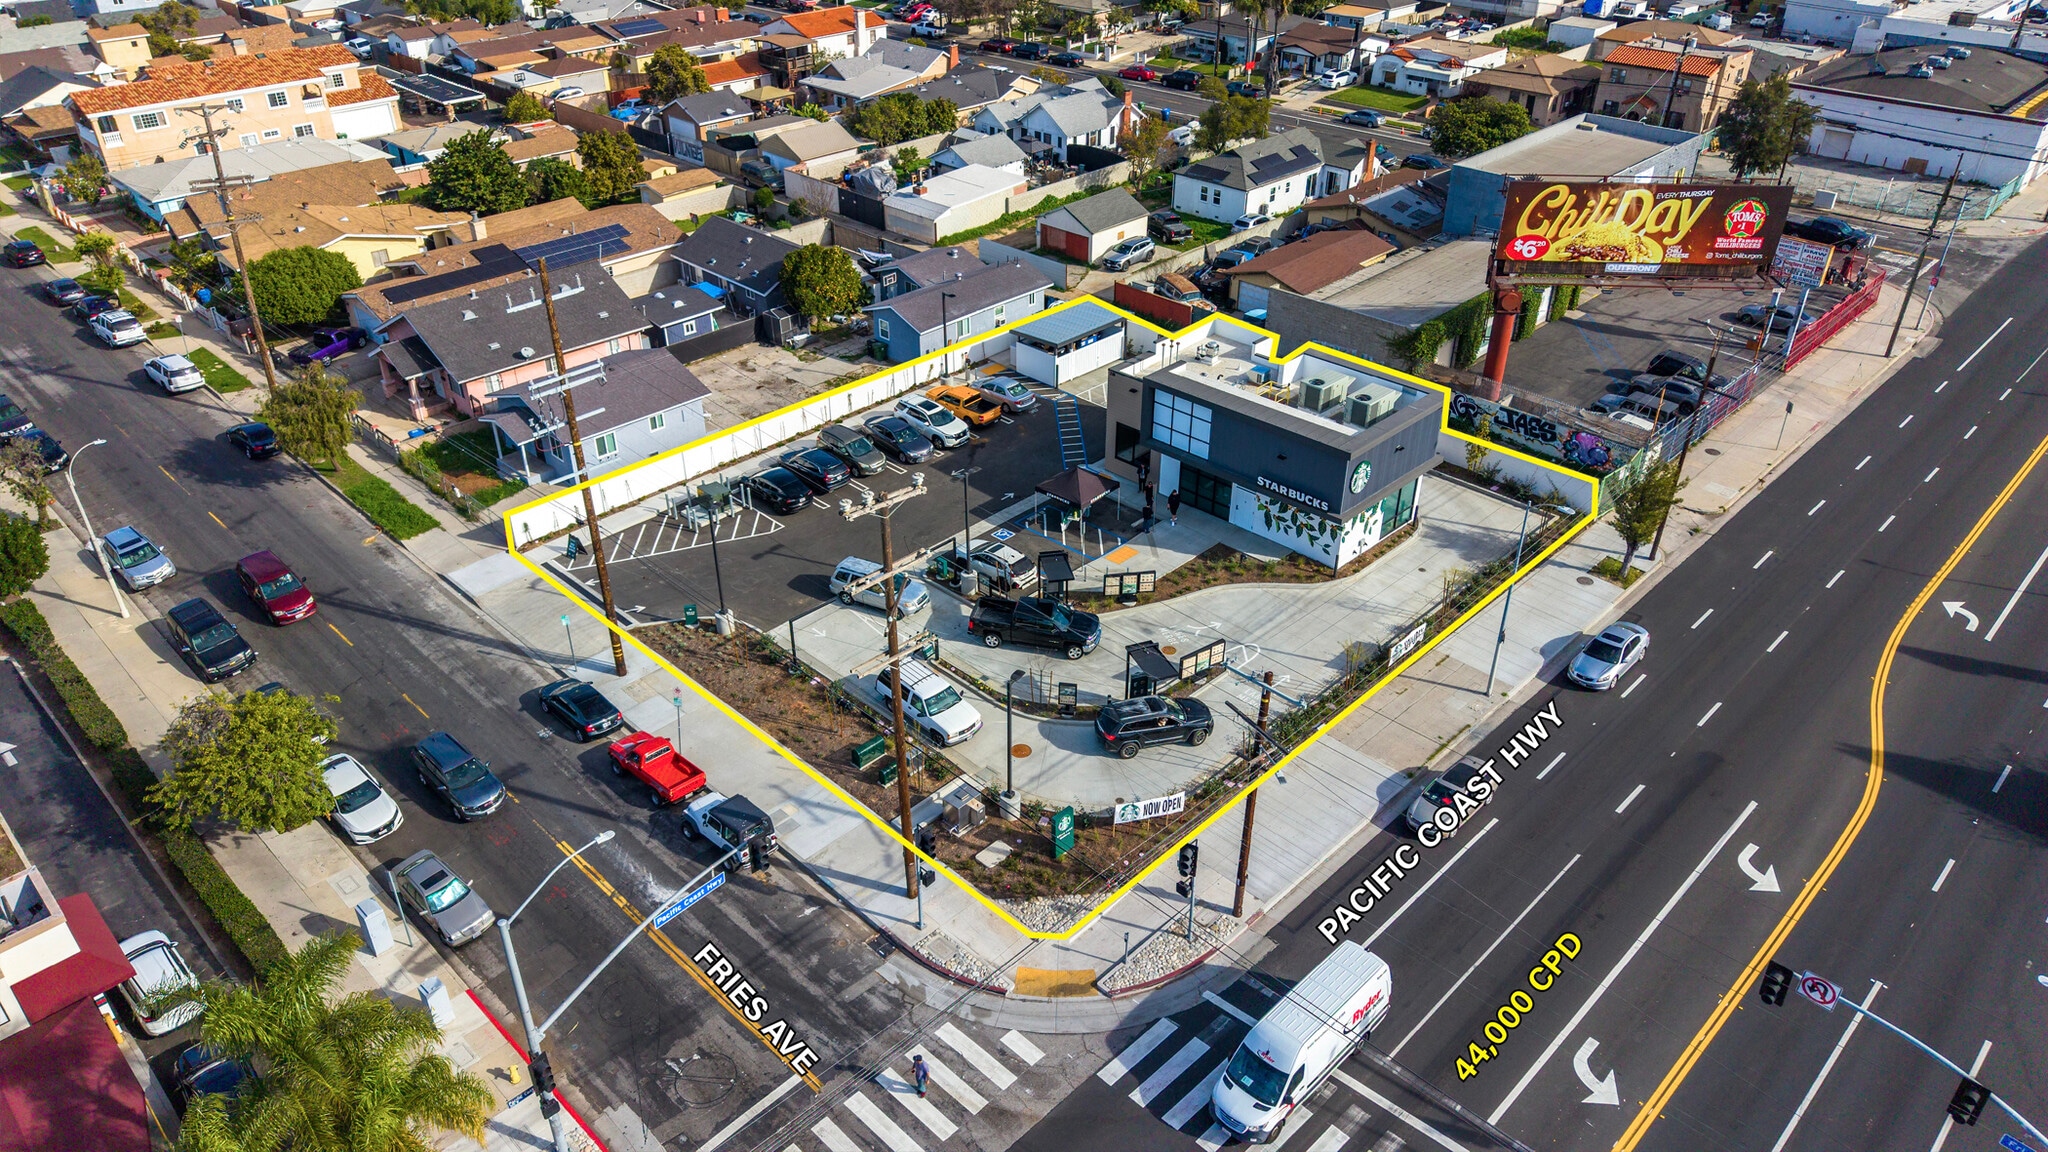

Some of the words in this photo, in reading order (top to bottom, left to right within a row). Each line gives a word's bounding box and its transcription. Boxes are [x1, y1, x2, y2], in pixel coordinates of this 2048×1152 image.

[1679, 189, 1715, 197] THURSDAY
[1613, 188, 1713, 245] Day
[1804, 249, 1827, 257] BMW
[1257, 476, 1329, 511] STARBUCKS
[1143, 802, 1160, 817] NOW
[1162, 796, 1182, 812] OPEN
[656, 905, 682, 925] Pacific
[683, 890, 705, 906] Coast
[706, 877, 723, 891] Hwy
[1352, 988, 1382, 1024] Ryder
